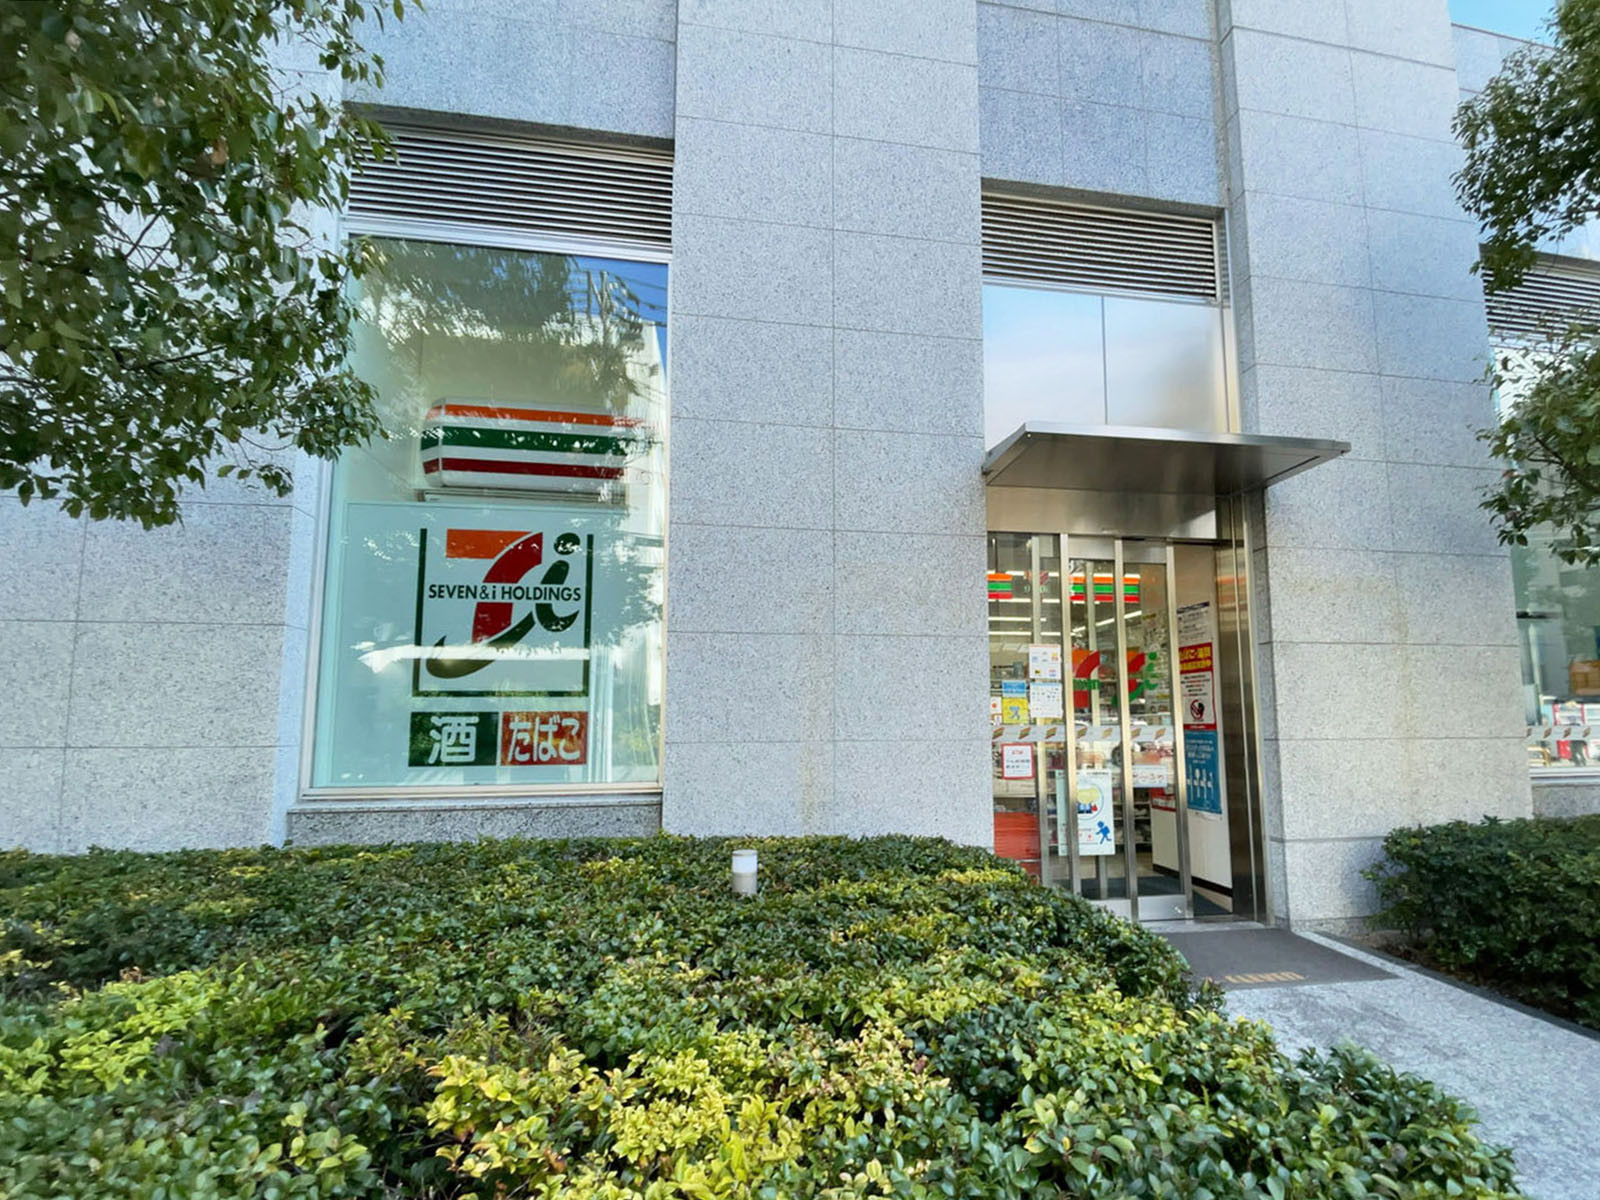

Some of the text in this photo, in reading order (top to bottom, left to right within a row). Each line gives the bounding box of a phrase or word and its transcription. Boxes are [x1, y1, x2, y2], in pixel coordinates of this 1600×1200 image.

[501, 584, 582, 602] HOLDINGS
[428, 715, 479, 765] 酒
[507, 715, 581, 763] たばこ
